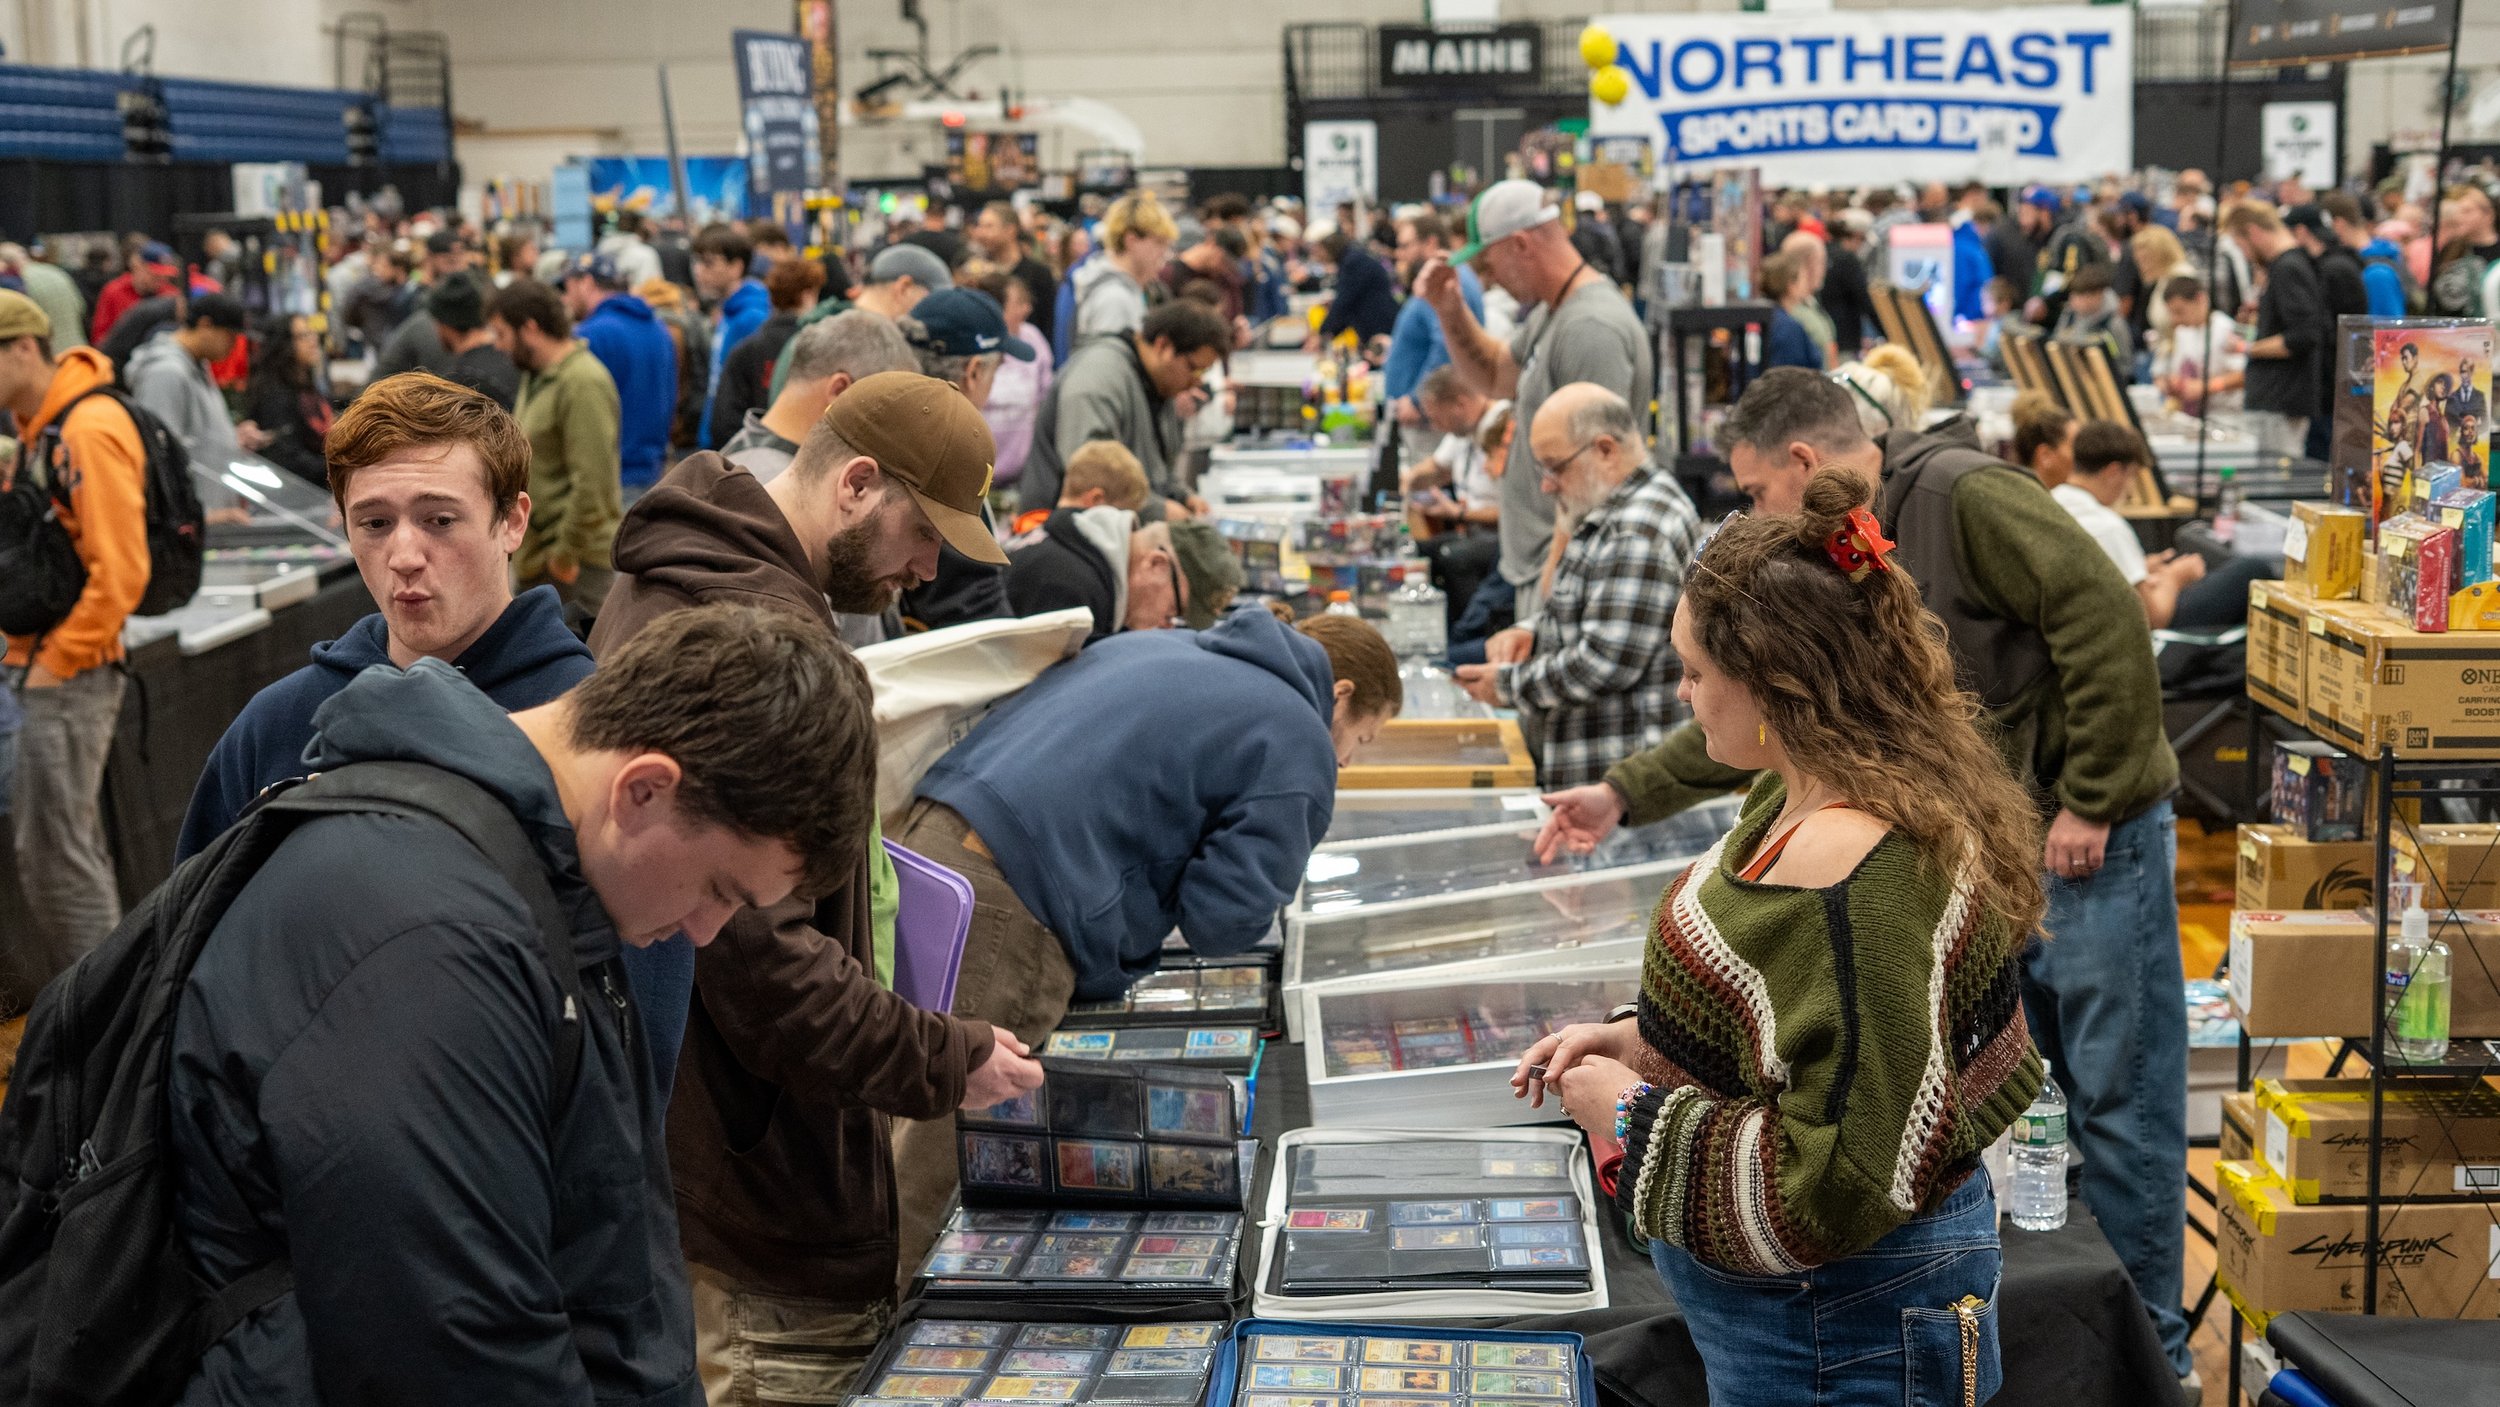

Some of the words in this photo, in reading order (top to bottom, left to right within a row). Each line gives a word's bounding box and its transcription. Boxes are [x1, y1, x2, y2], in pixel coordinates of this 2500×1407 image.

[1392, 39, 1532, 75] MAINE
[1614, 31, 2112, 101] NORTHEAST
[1679, 104, 1830, 154] SPORTS
[1833, 103, 1936, 143] CARD
